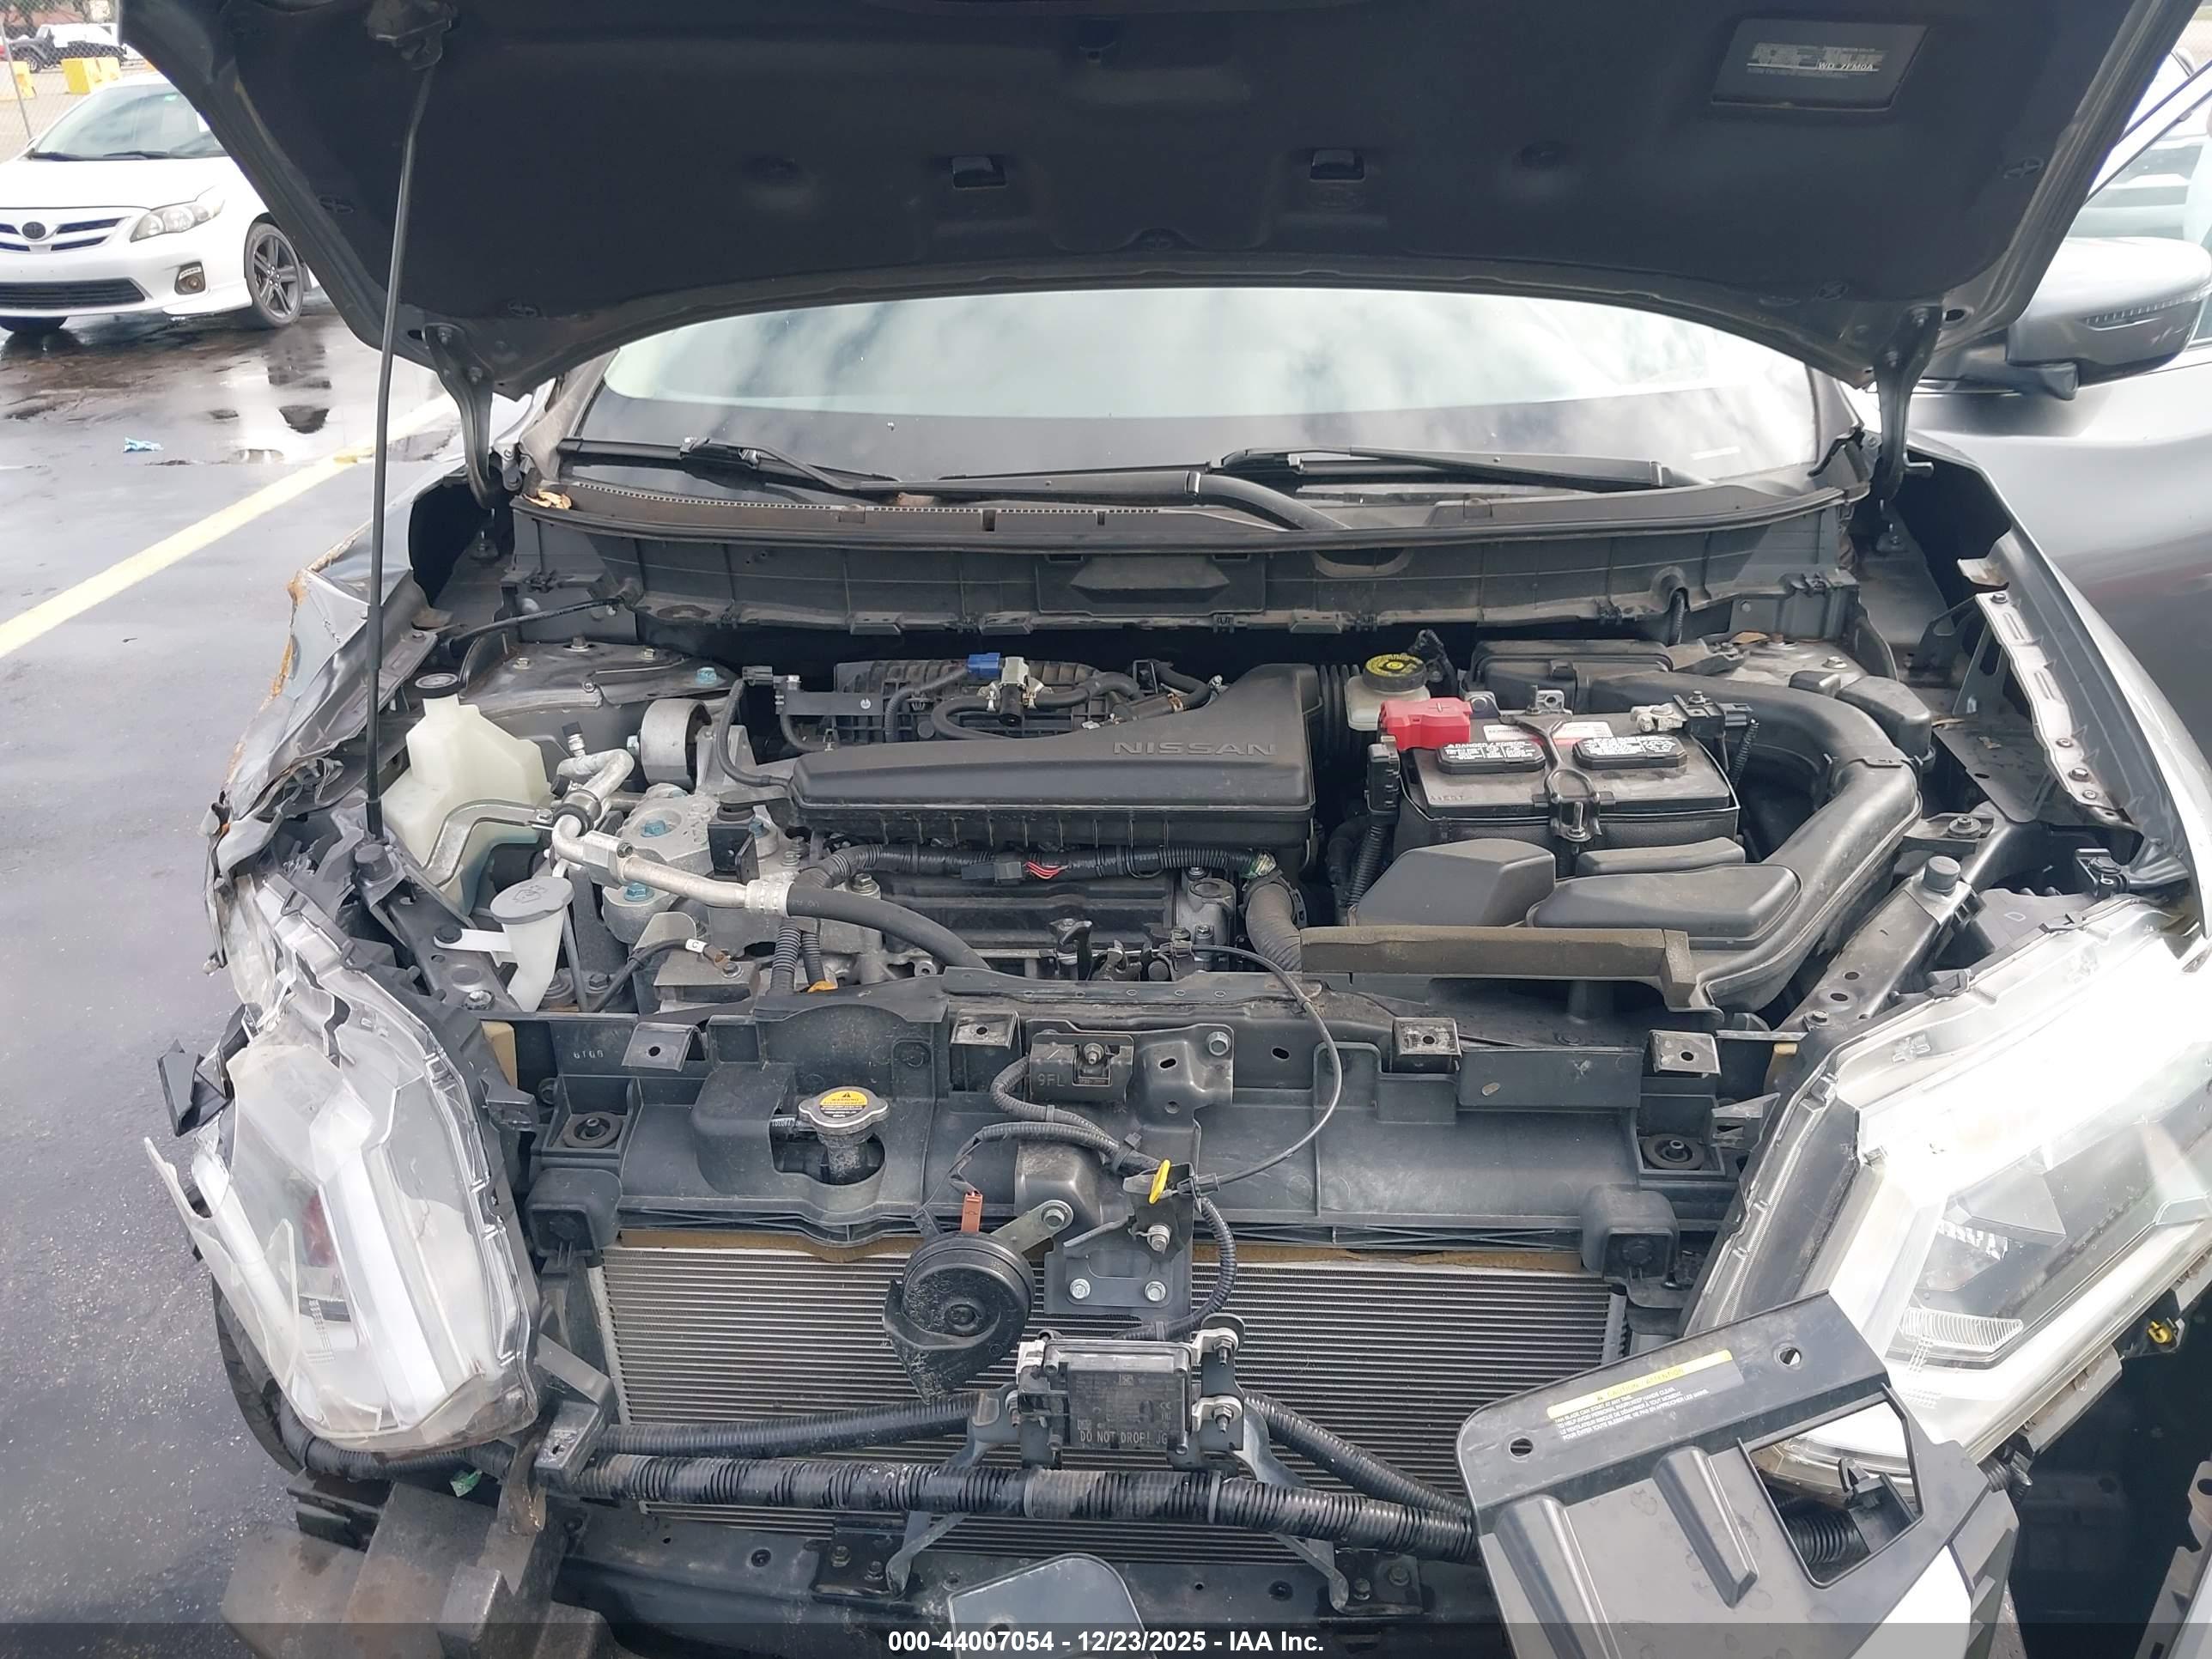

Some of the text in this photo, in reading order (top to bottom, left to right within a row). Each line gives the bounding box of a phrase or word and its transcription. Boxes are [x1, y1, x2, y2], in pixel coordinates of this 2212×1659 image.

[1114, 742, 1276, 756] NISSAN
[1037, 1073, 1065, 1087] 9FL
[1080, 1430, 1092, 1443] DO
[1097, 1431, 1116, 1443] NOT
[1121, 1431, 1150, 1443] DROP!
